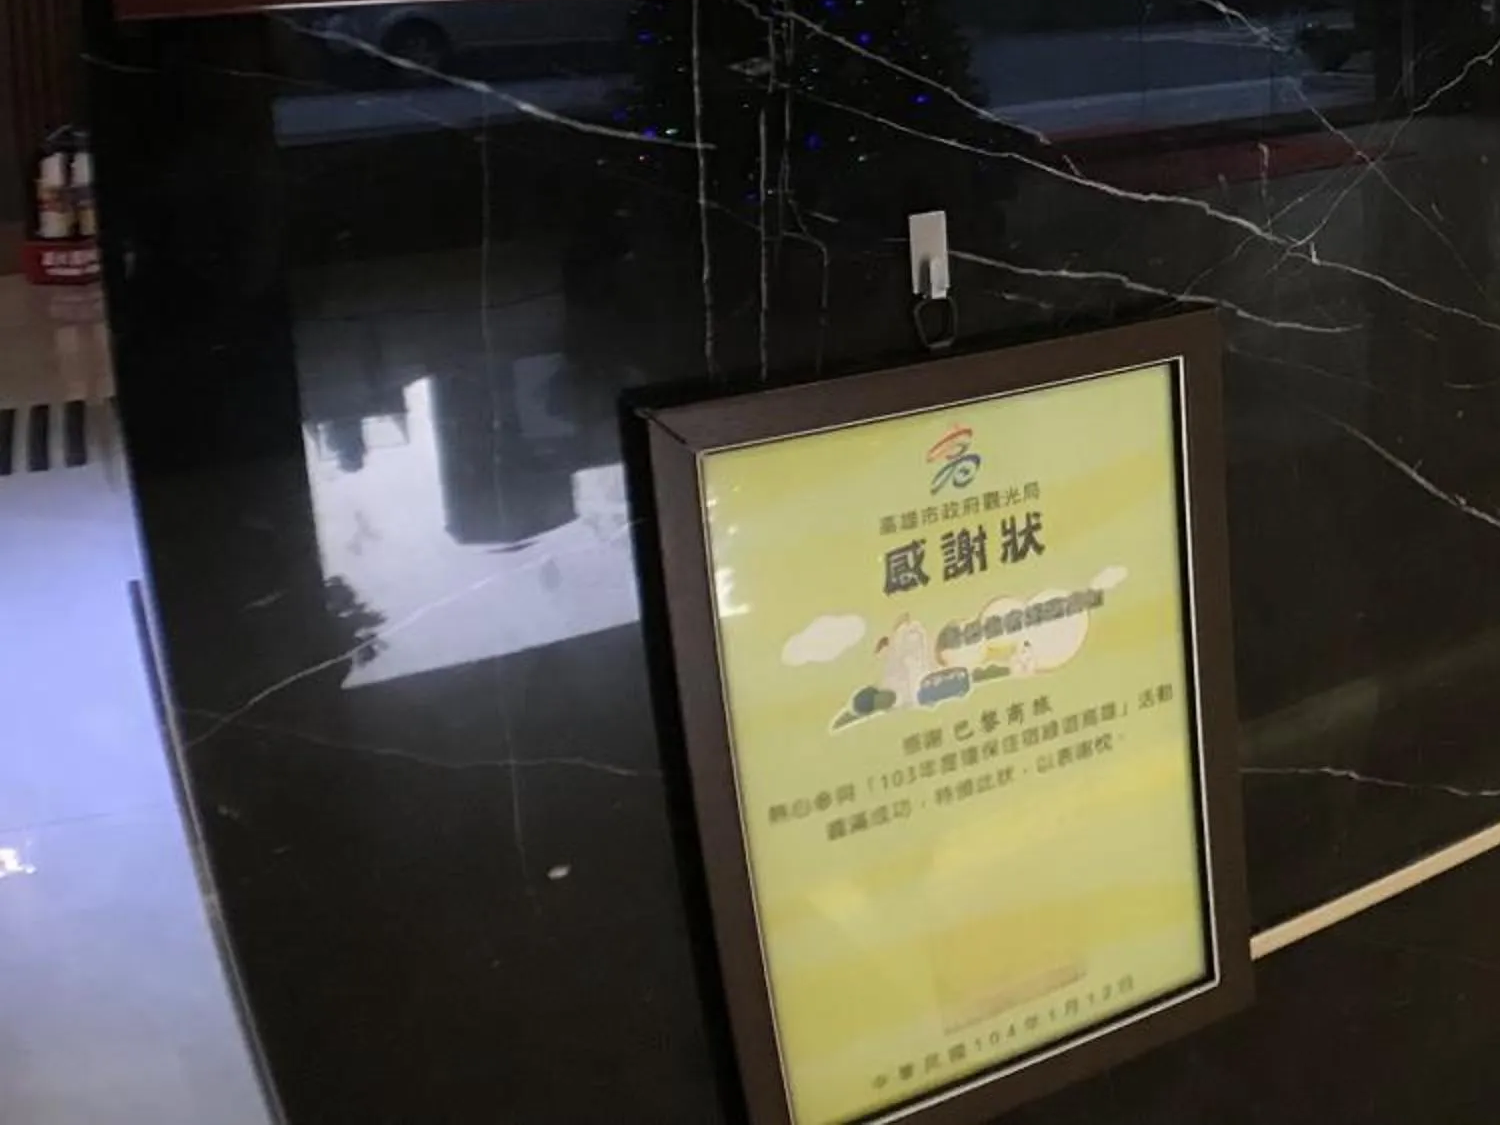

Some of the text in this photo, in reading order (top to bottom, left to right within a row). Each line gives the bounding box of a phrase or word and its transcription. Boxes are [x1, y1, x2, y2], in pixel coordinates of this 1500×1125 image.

[879, 480, 1041, 536] 高雄市政府觀光局
[883, 511, 1046, 597] 感謝狀
